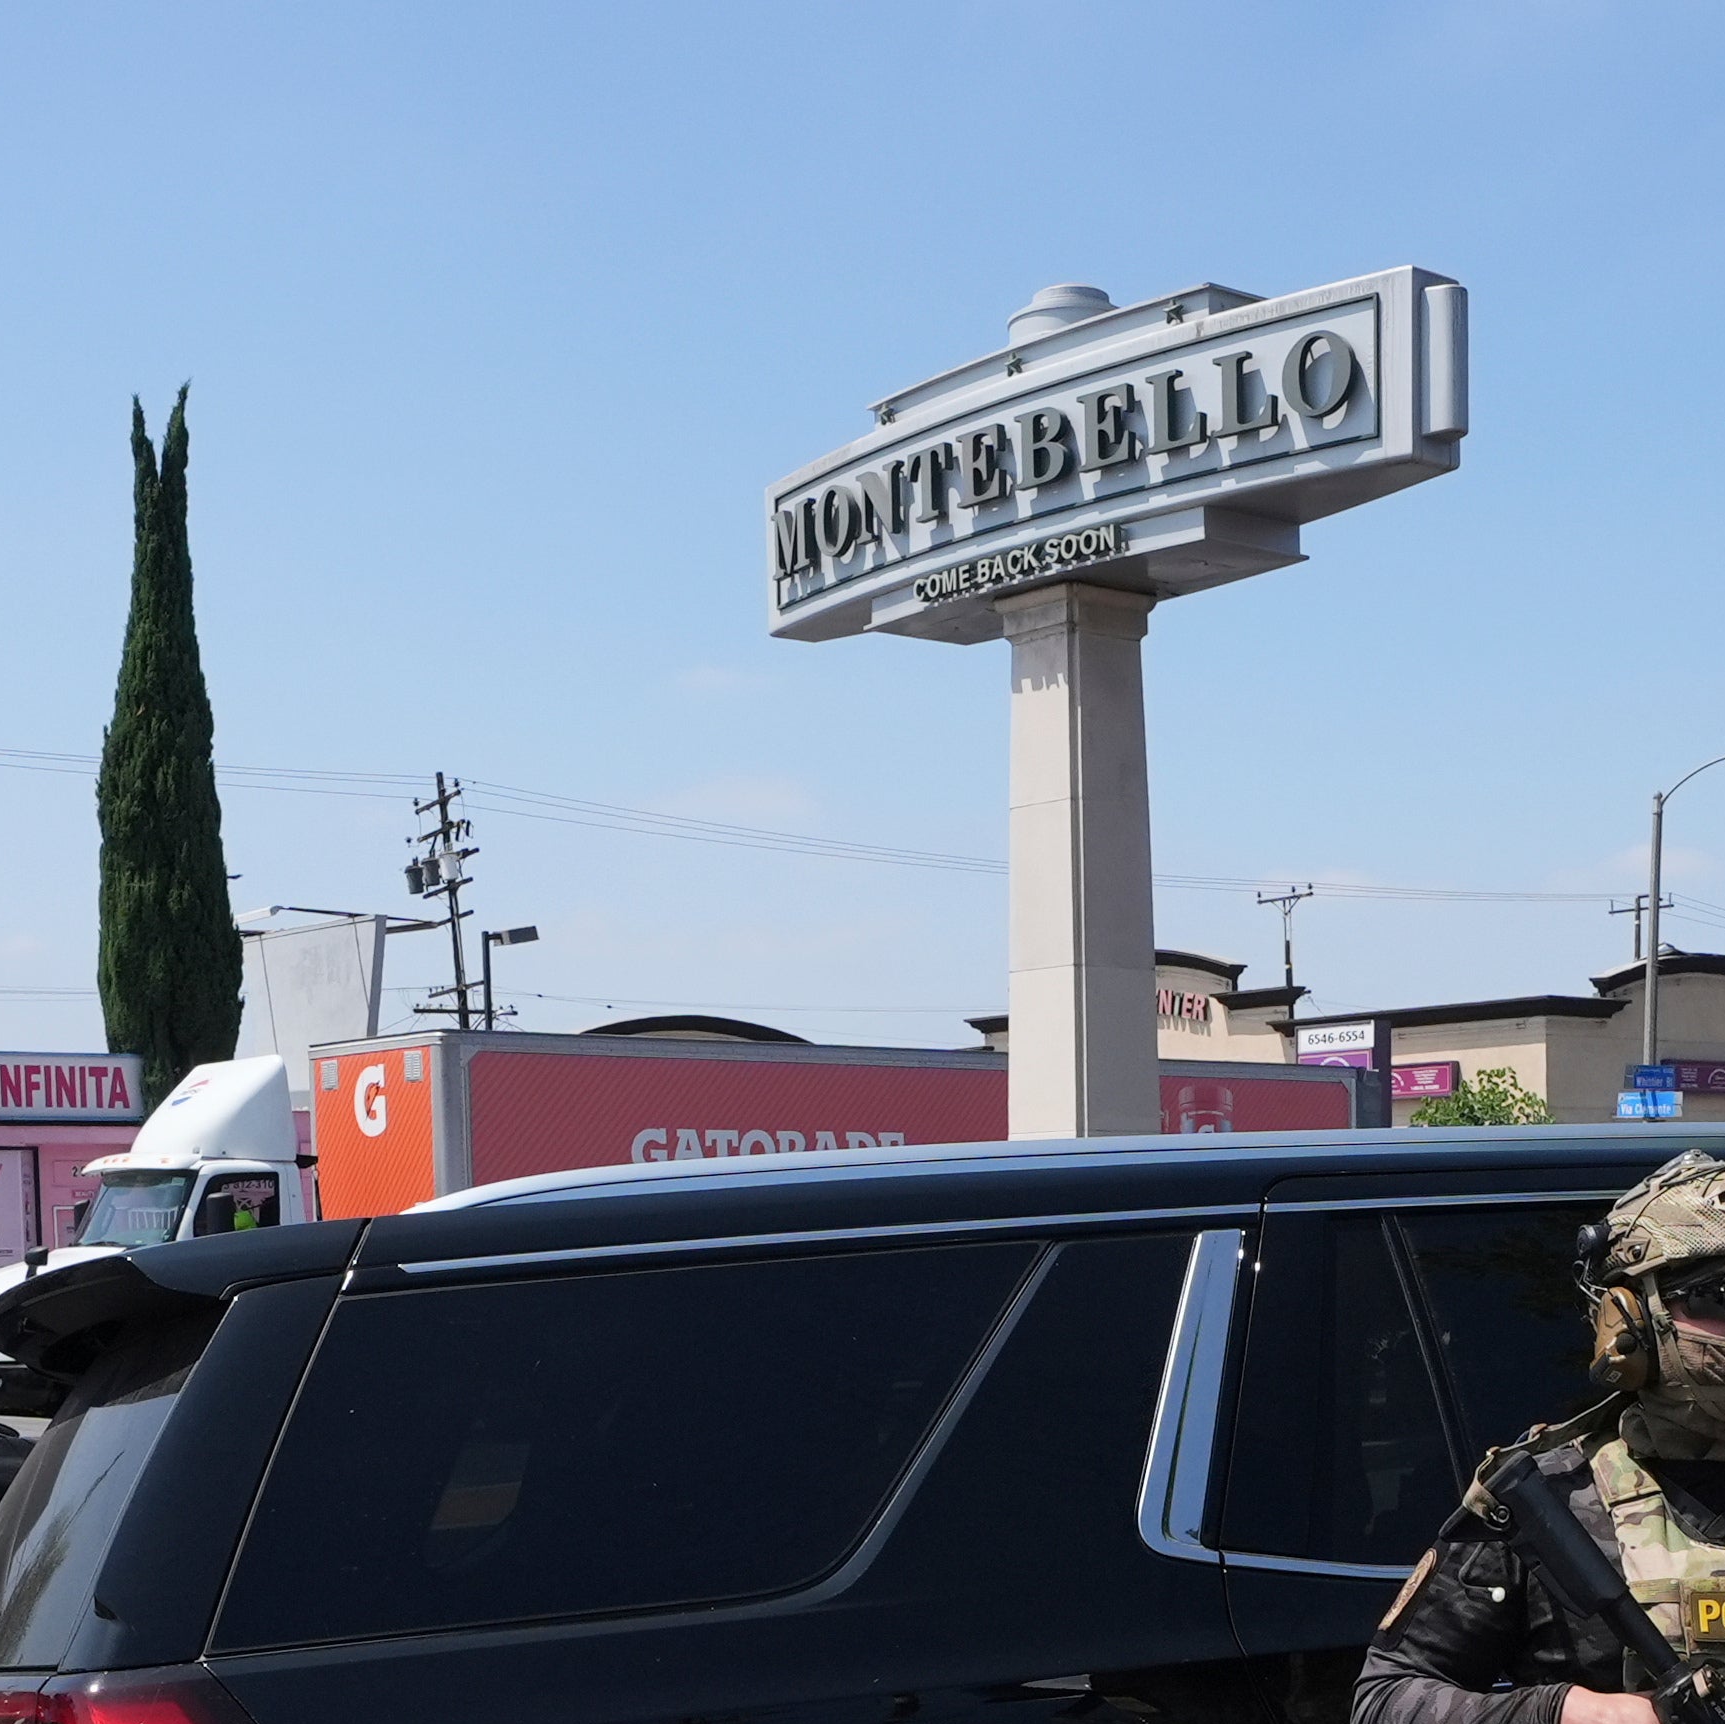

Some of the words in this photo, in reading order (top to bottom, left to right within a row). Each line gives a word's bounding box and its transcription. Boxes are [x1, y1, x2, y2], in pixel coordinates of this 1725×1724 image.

[773, 329, 1355, 582] MONTEBELLO
[912, 564, 972, 602] COME
[977, 543, 1041, 584] BACK
[1044, 523, 1116, 564] SOON
[1155, 989, 1208, 1023] NTER
[1307, 1029, 1366, 1046] 6546-6554
[354, 1064, 387, 1138] G
[1620, 1103, 1633, 1115] Via
